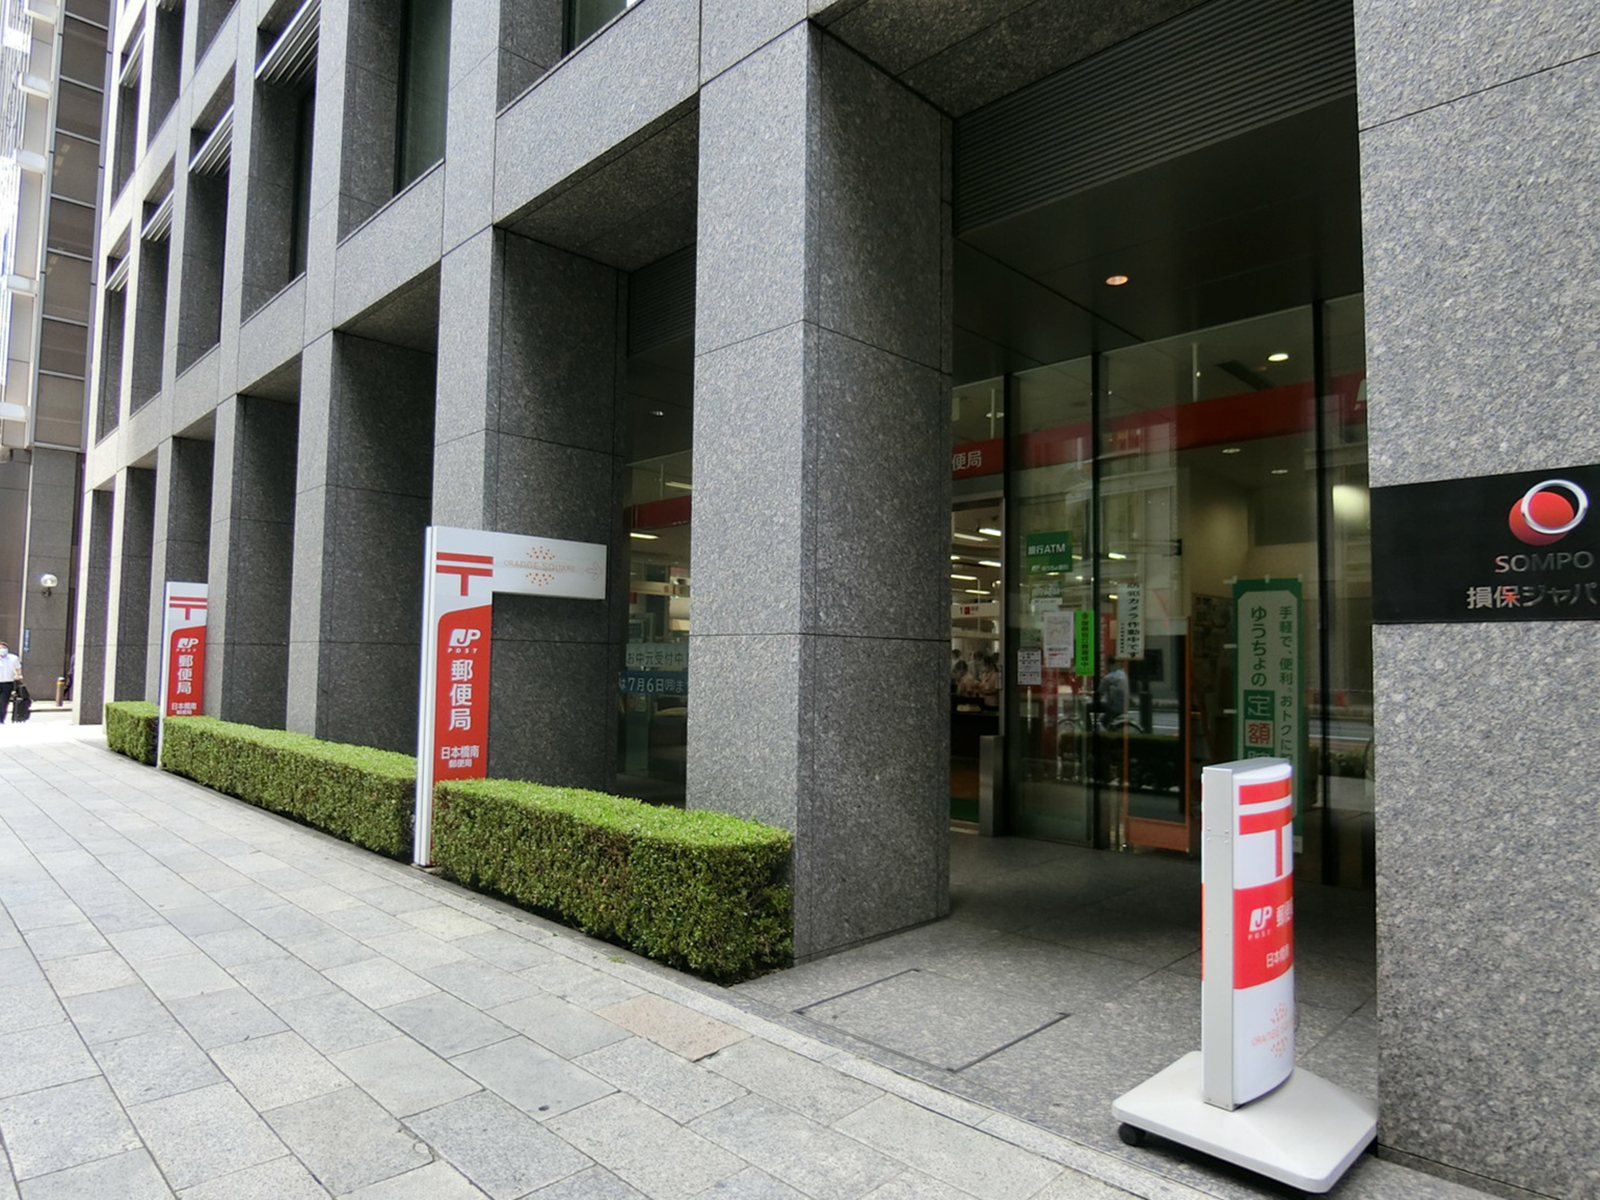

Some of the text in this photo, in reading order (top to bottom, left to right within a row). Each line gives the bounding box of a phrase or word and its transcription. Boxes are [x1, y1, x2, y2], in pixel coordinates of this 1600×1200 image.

[503, 559, 539, 570] ORANGE
[1494, 550, 1595, 574] SOMPO
[626, 651, 685, 666] お中元受付中
[177, 655, 194, 694] 郵便局
[449, 660, 473, 731] 郵便局
[441, 745, 480, 760] 日本橋南
[1248, 929, 1271, 940] POST
